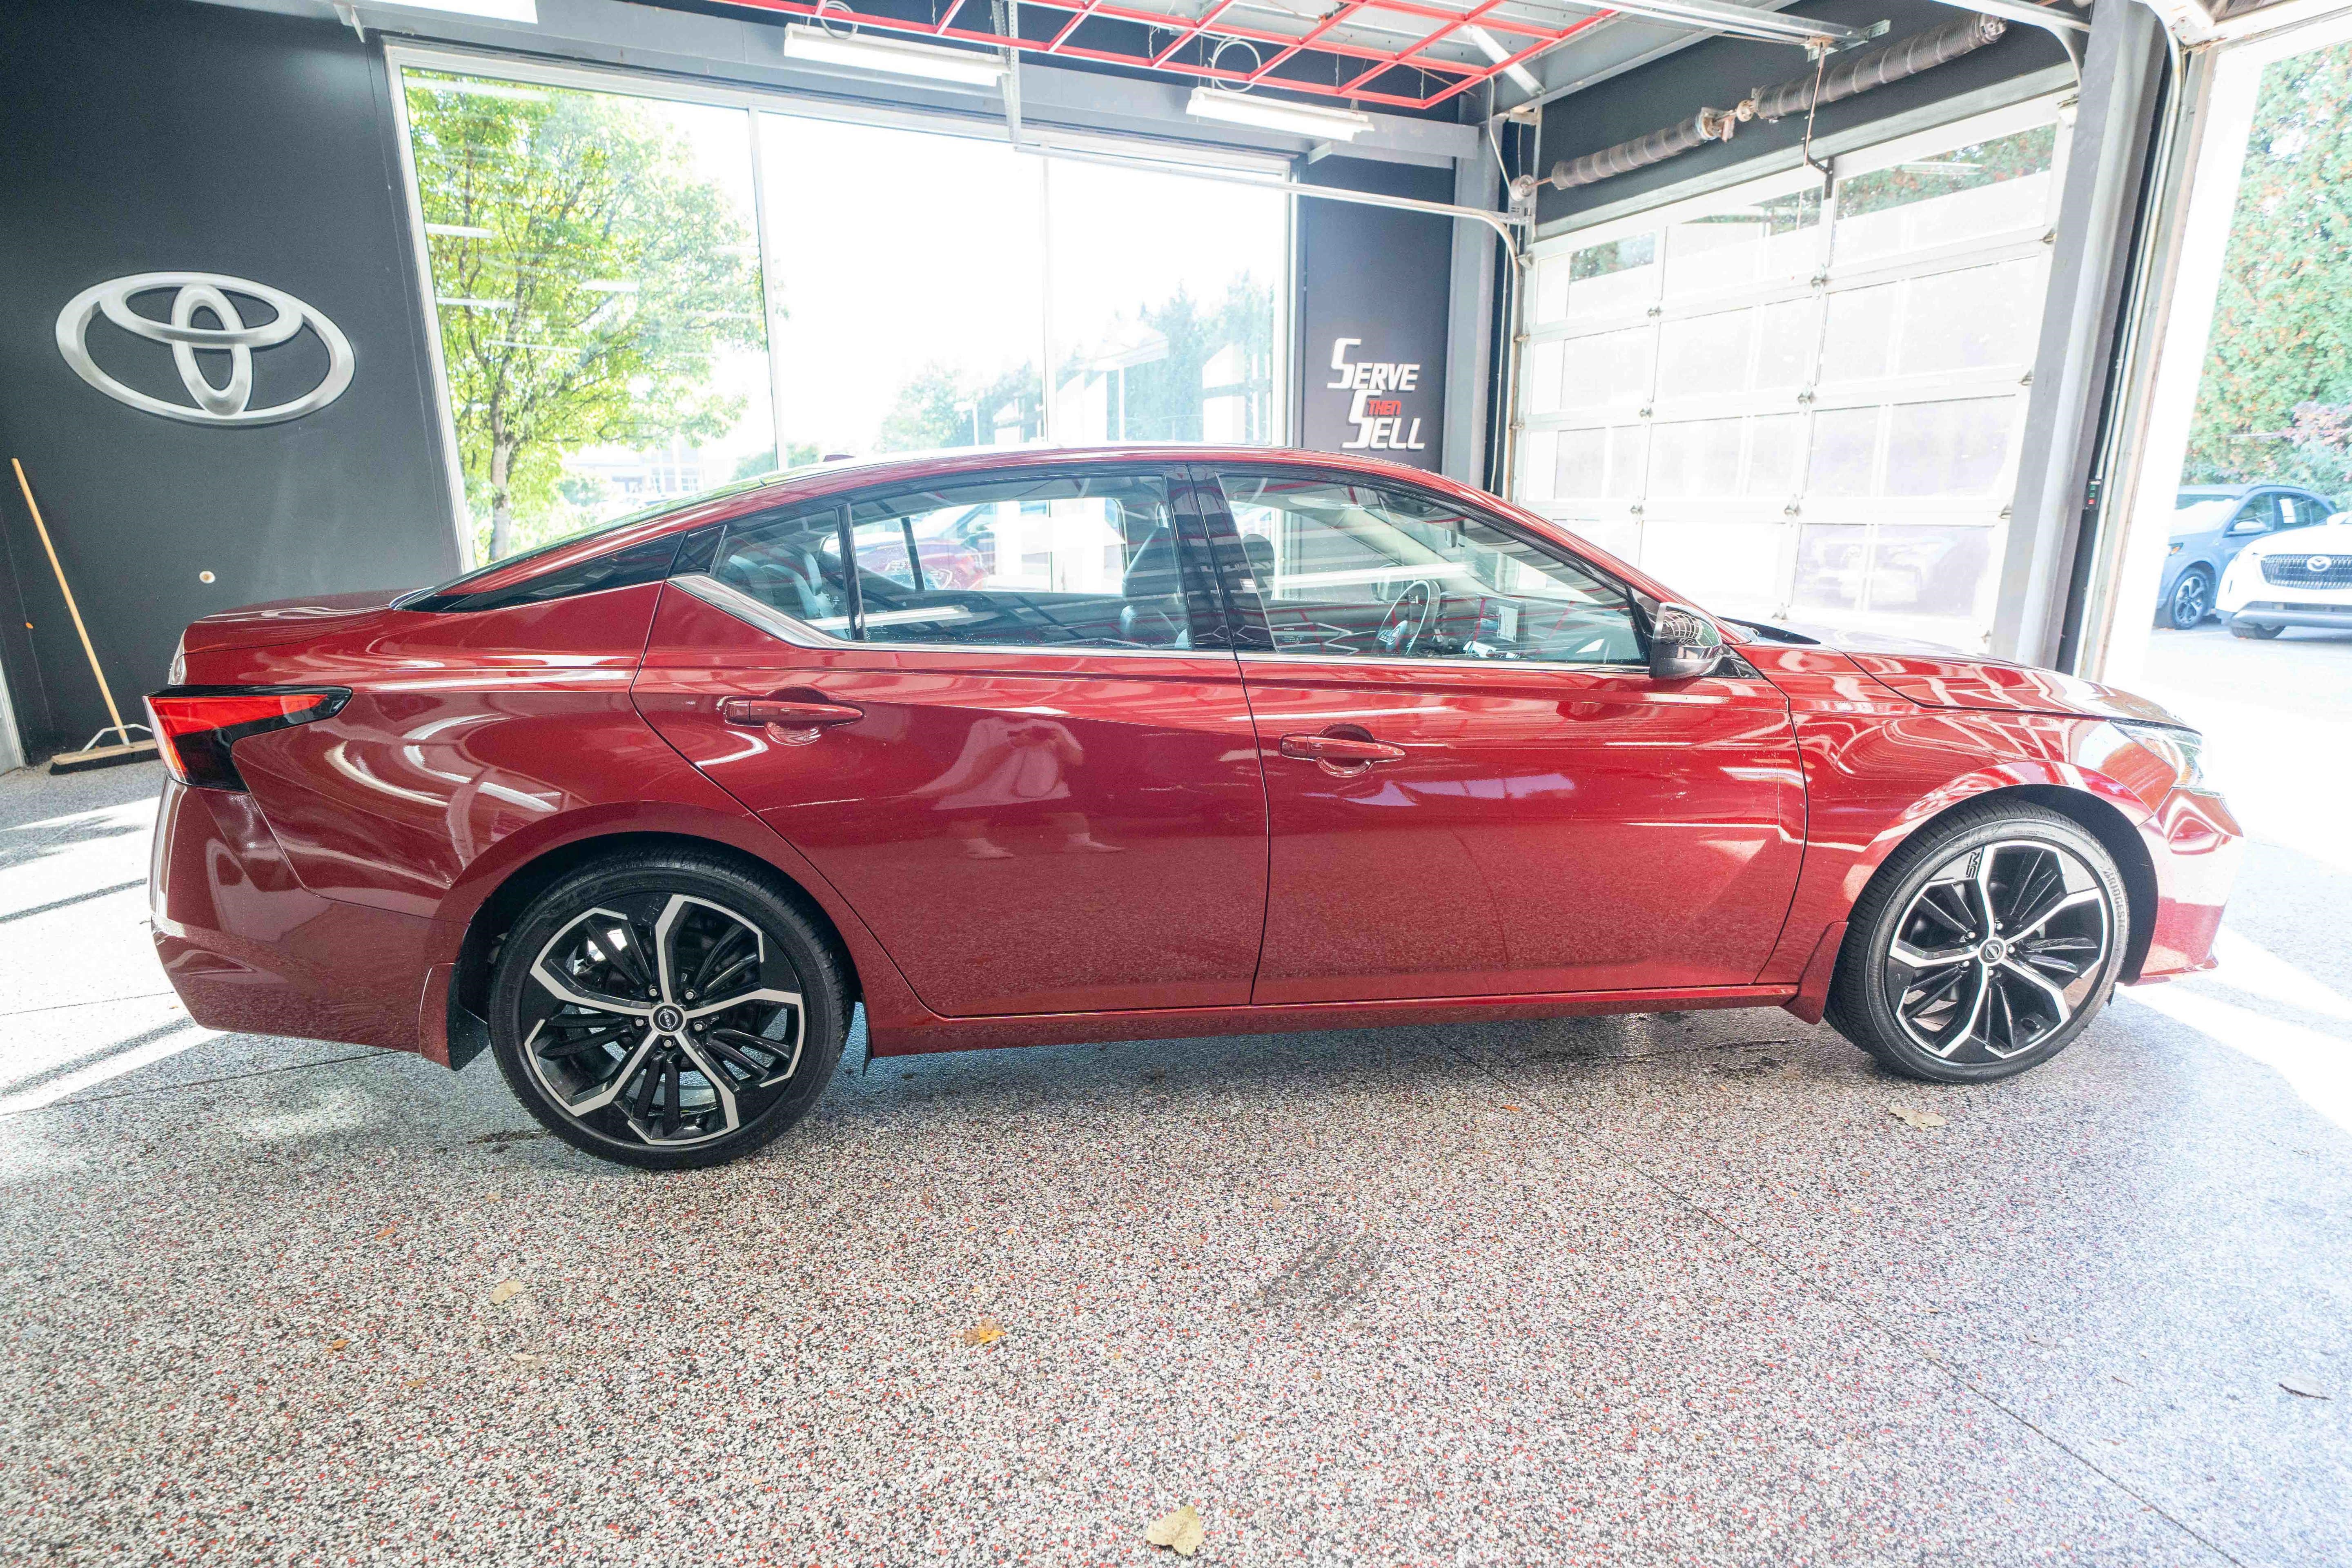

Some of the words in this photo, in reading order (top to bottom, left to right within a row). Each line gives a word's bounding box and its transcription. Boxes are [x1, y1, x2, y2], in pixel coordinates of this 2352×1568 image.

[1327, 338, 1421, 391] SERVE
[1342, 390, 1425, 449] SELL
[1966, 852, 1980, 878] SR
[2102, 867, 2126, 946] BRIDGESTO
[662, 1009, 673, 1030] NISSAN
